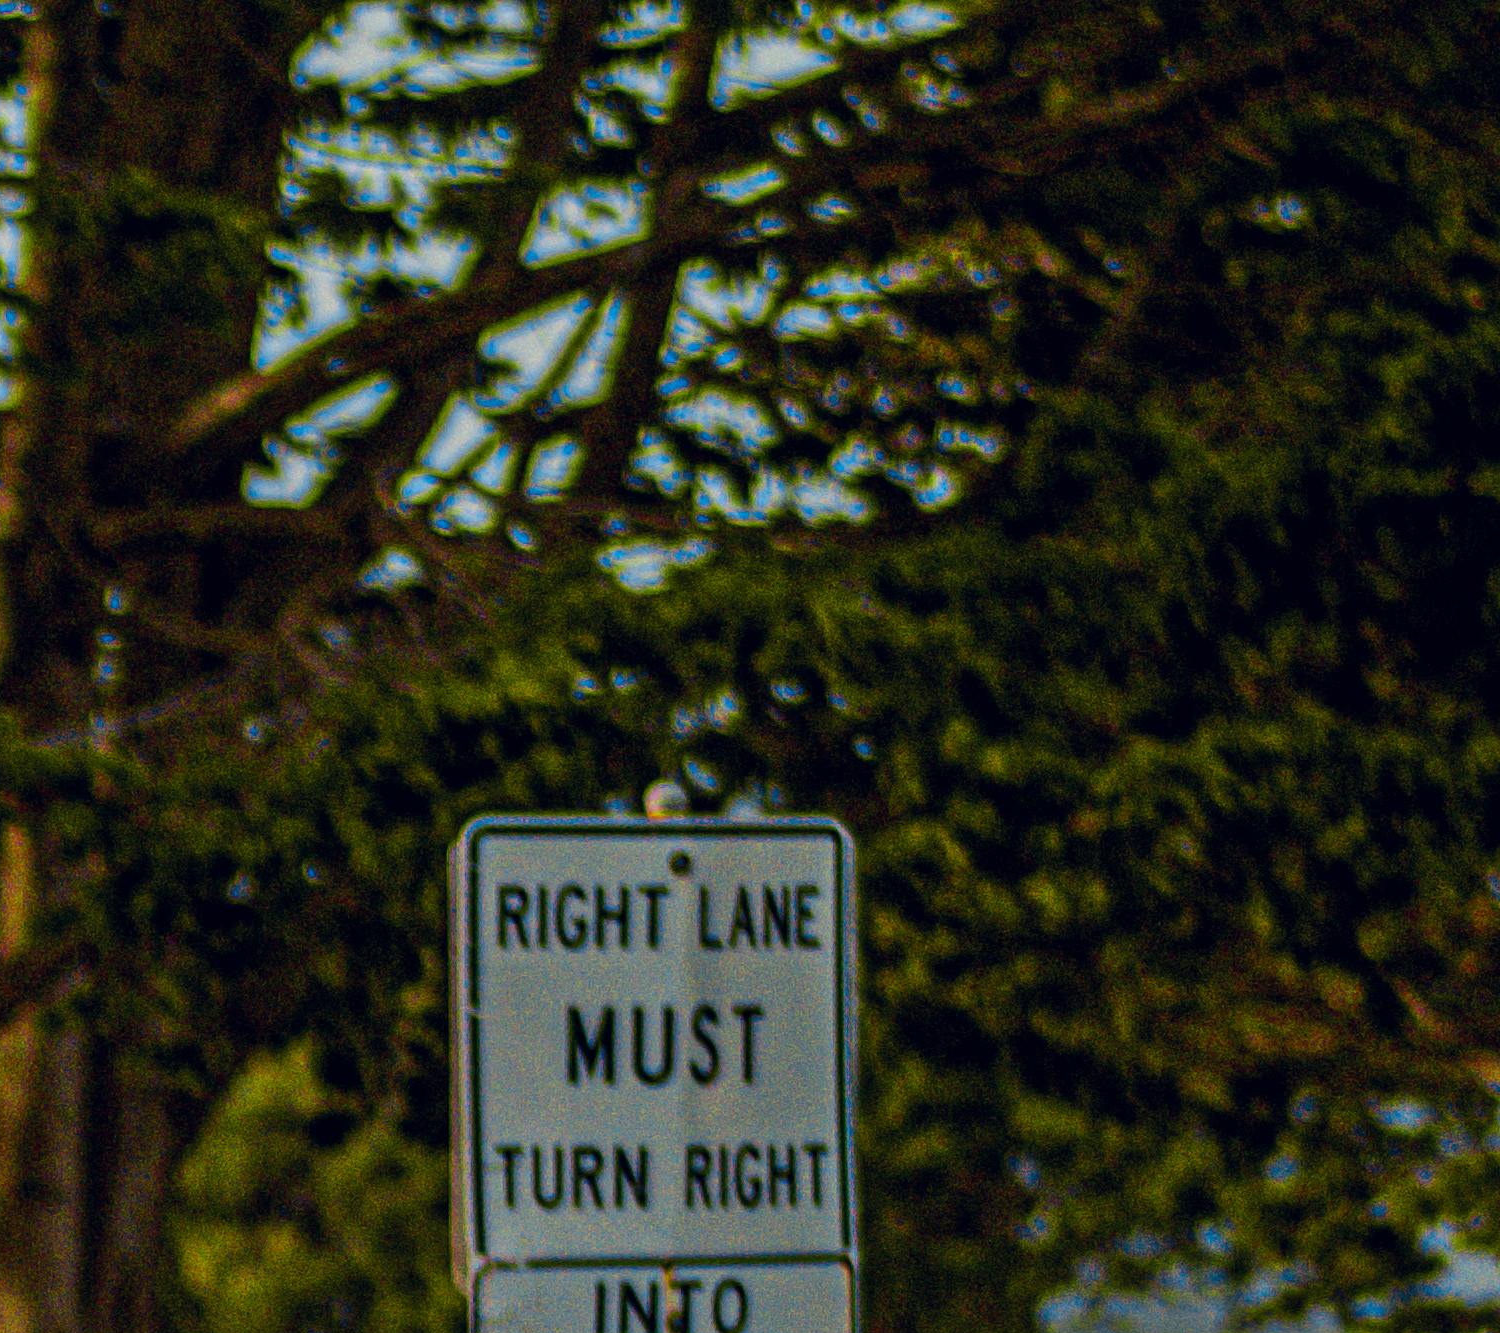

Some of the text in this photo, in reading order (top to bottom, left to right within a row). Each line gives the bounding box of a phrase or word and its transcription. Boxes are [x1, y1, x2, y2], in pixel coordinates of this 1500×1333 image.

[497, 885, 822, 950] RIGHT LANE
[565, 1005, 763, 1085] MUST
[496, 1144, 829, 1210] TURN RIGHT
